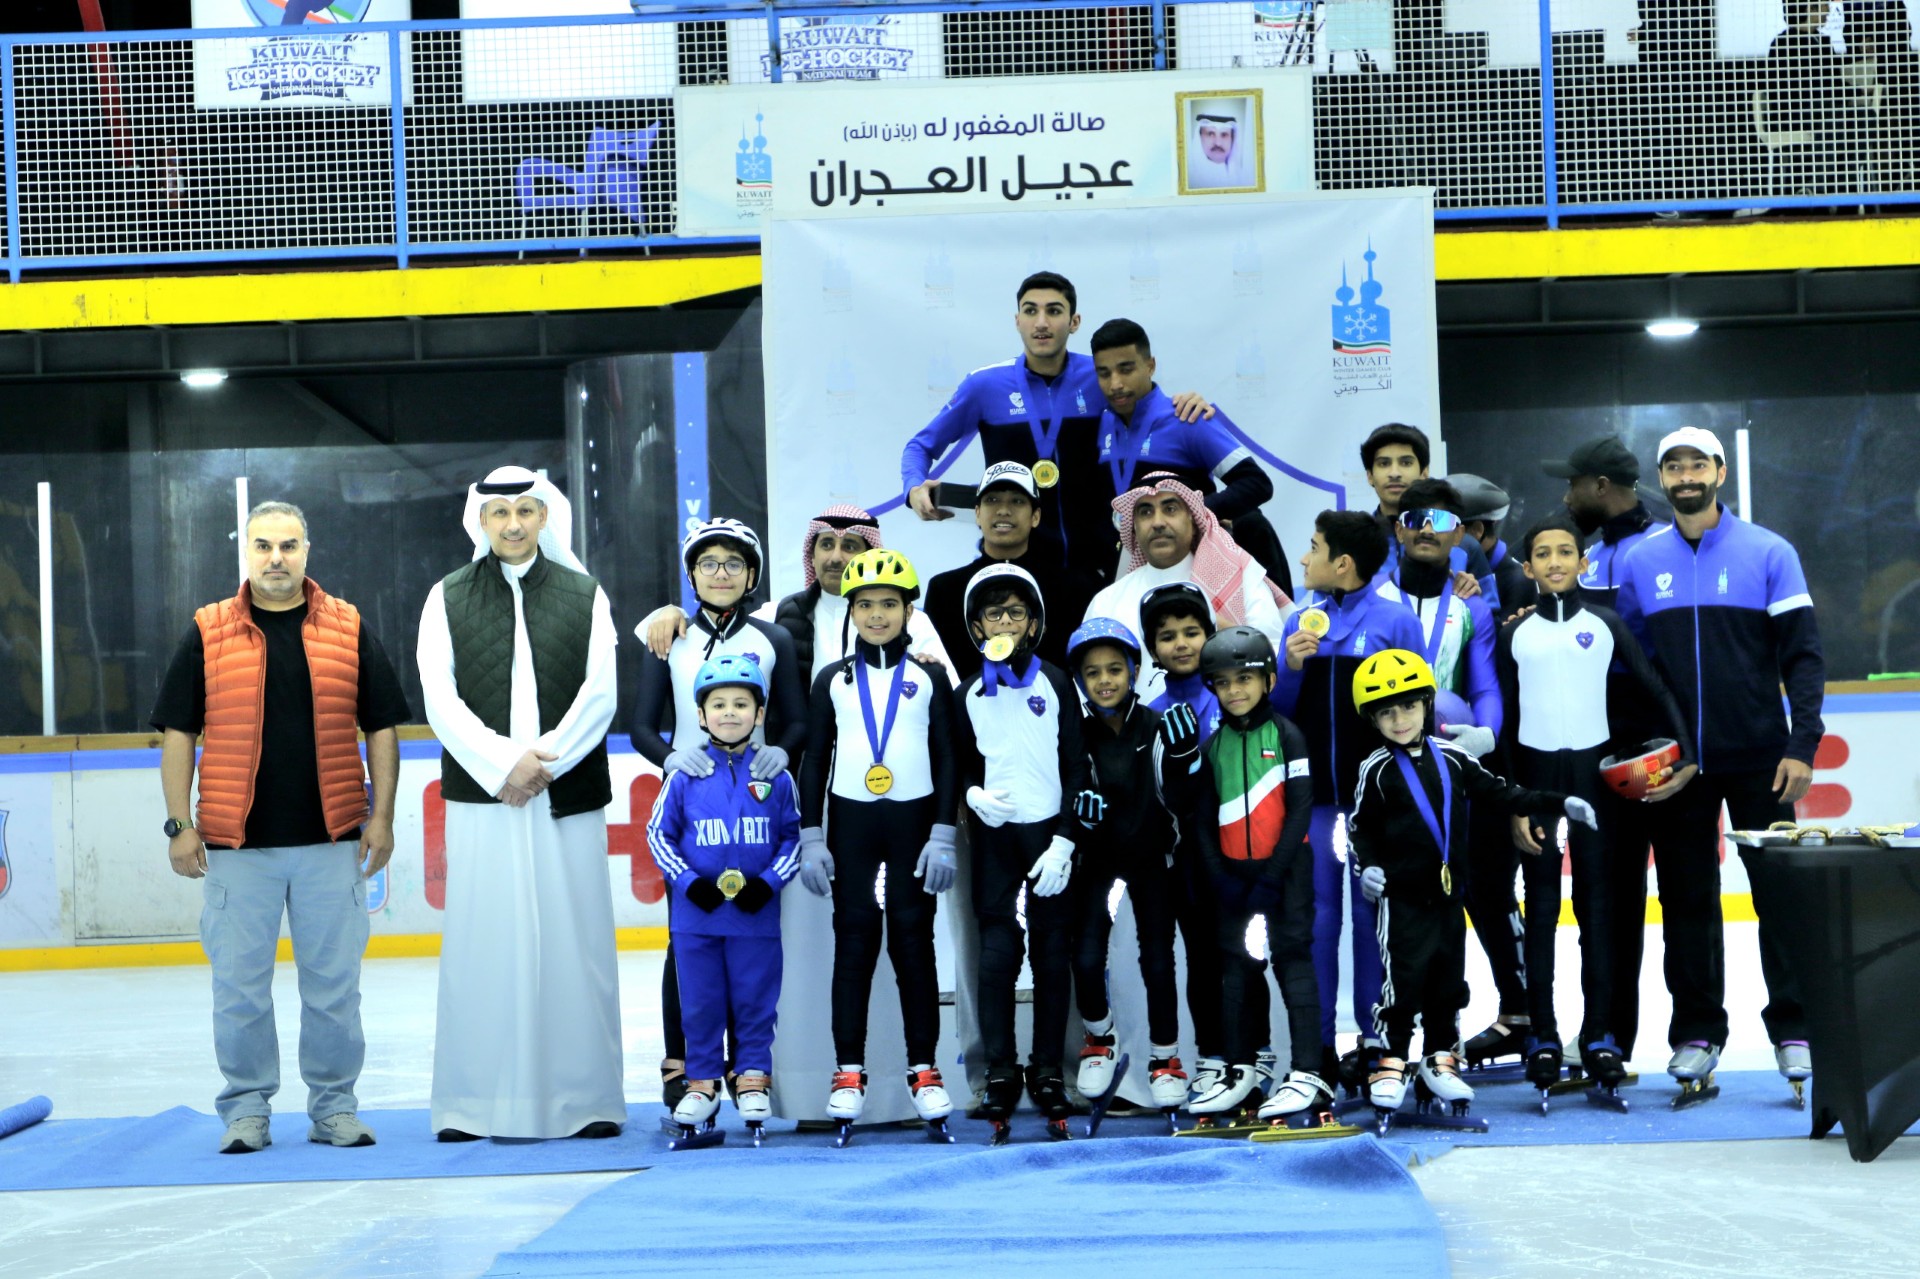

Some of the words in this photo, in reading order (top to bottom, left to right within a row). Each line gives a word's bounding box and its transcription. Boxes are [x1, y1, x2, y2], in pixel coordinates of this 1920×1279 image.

[784, 26, 888, 49] KUWAIT
[250, 42, 355, 64] KUWAIT
[923, 117, 948, 137] له
[953, 113, 1045, 141] المغفور
[1051, 111, 1106, 132] صالة
[810, 155, 988, 208] العجران
[1001, 154, 1135, 201] عجيل
[736, 190, 773, 199] KUWAIT
[1333, 356, 1391, 367] KUWAIT
[1334, 379, 1392, 397] الكويتي
